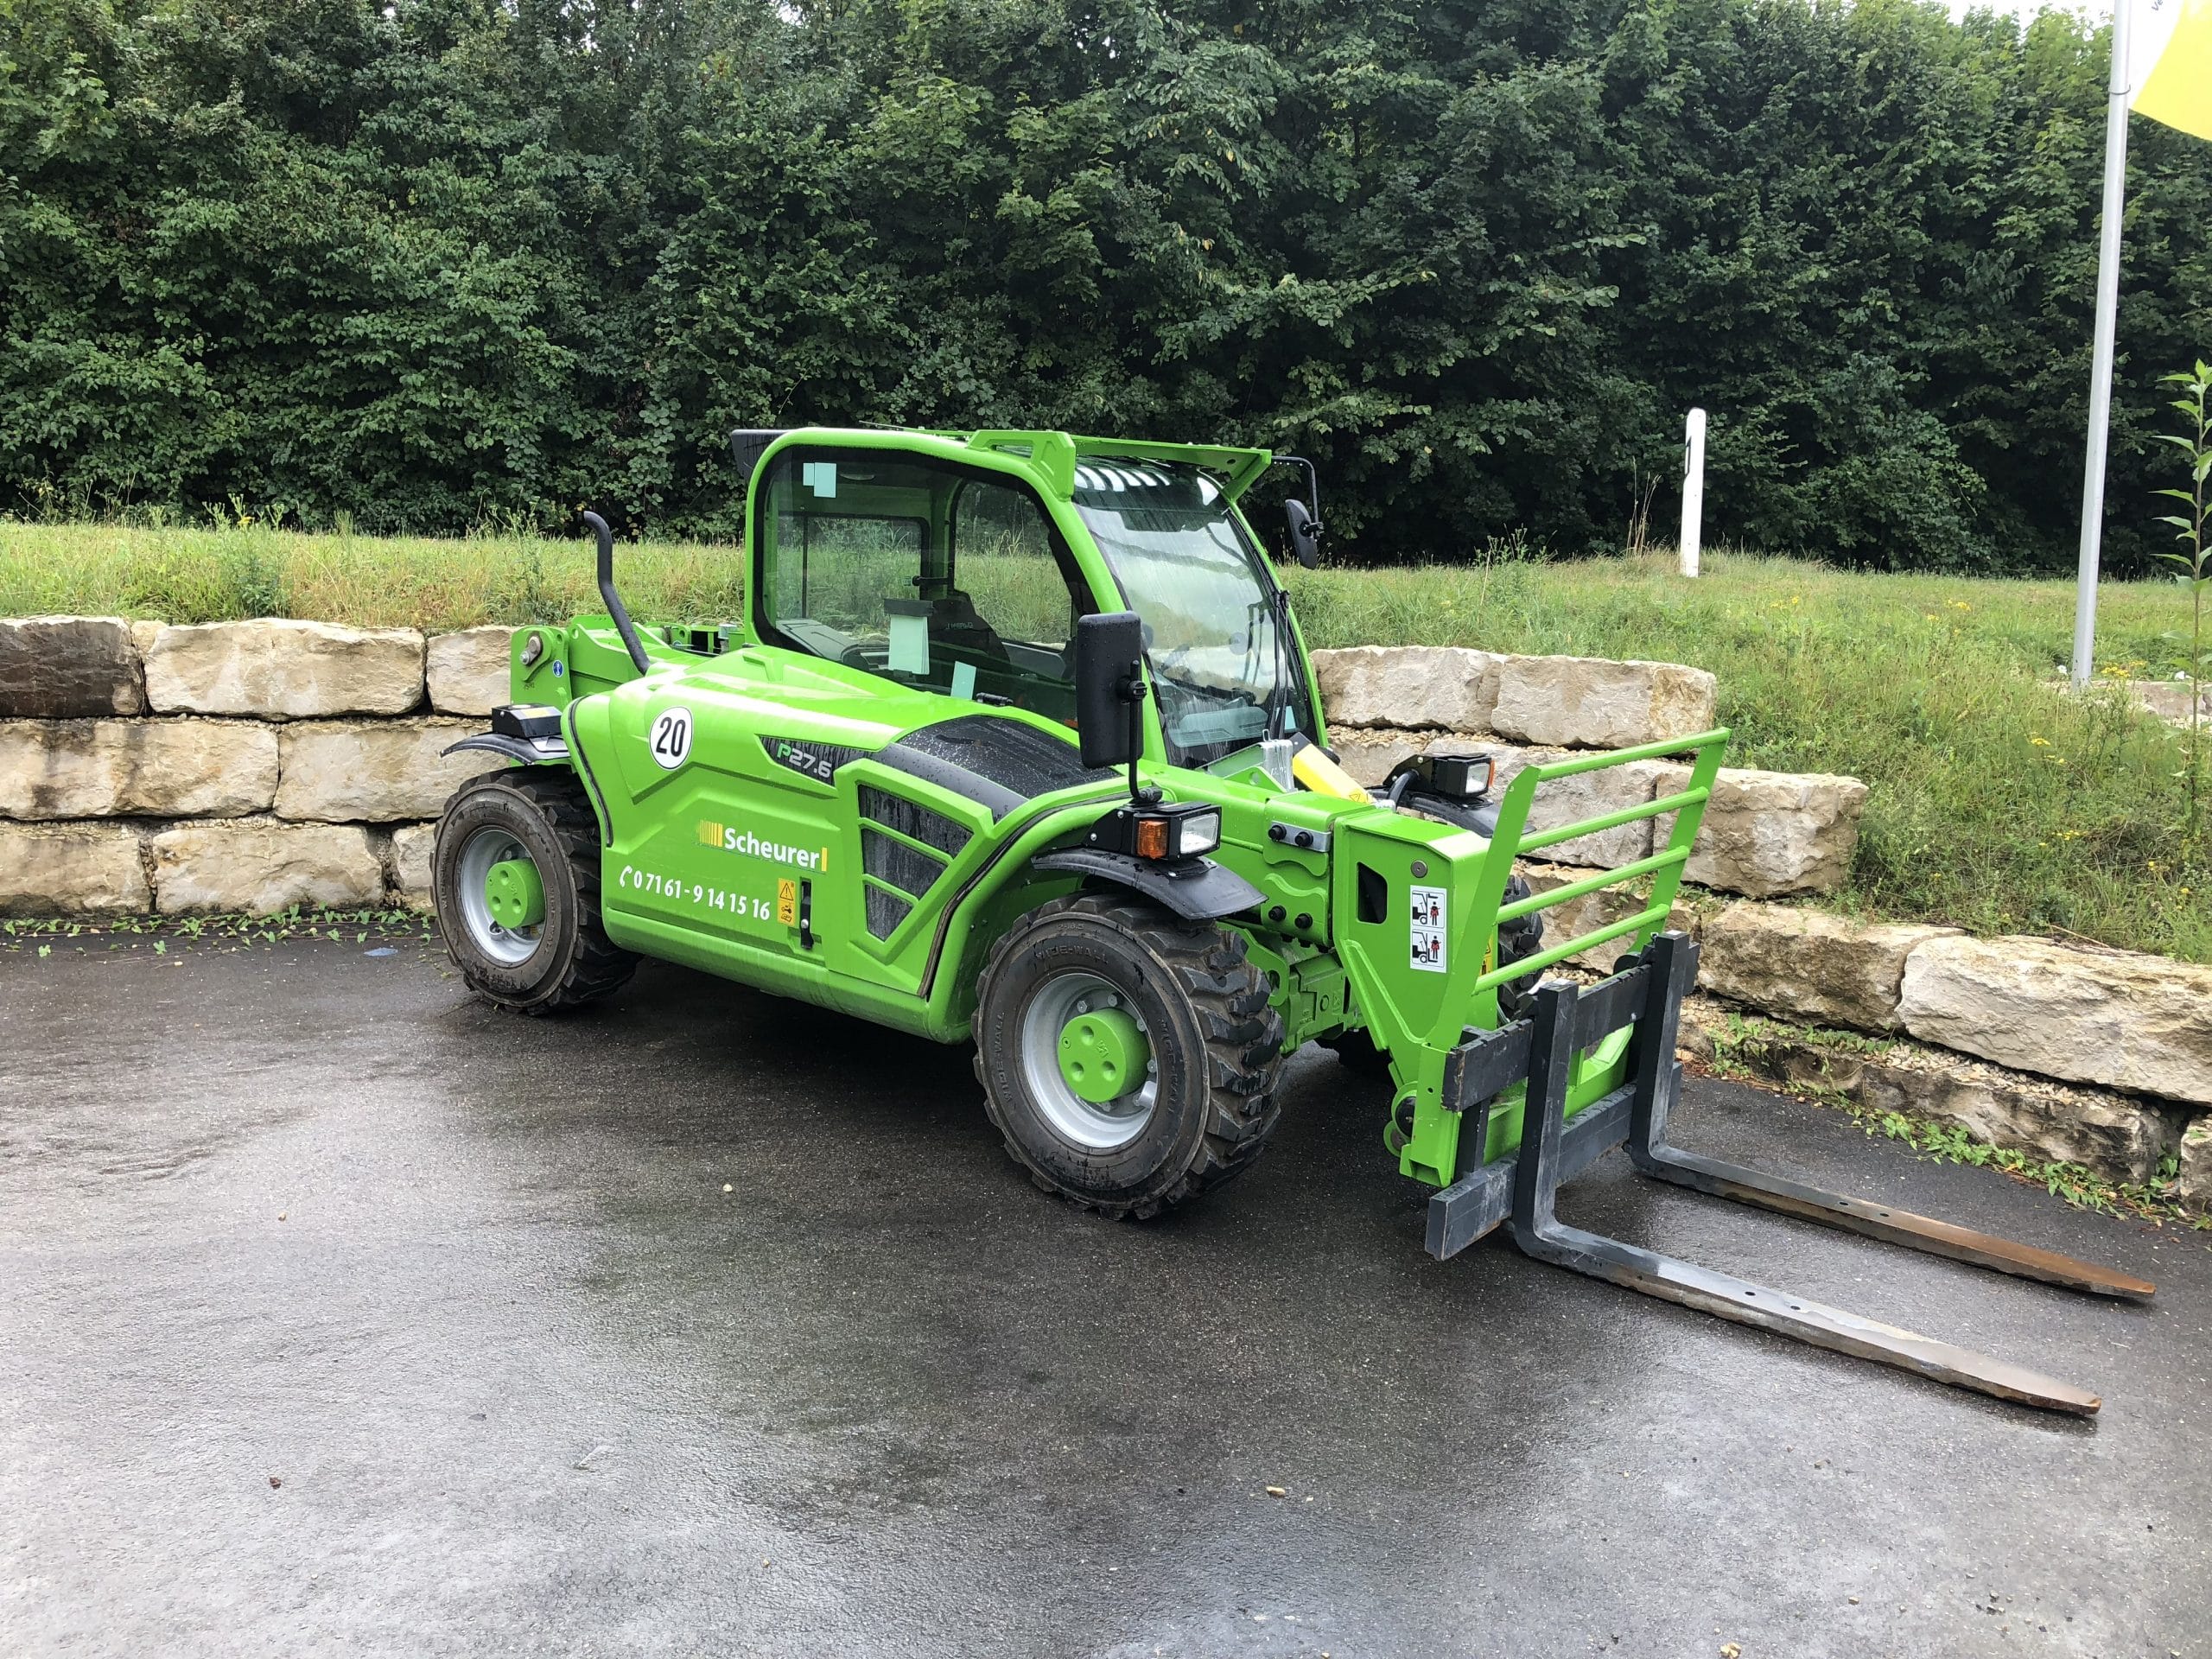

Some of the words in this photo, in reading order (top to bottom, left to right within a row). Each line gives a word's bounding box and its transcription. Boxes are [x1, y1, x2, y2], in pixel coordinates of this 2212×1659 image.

[656, 716, 686, 758] 20
[777, 742, 832, 779] P27.6
[724, 827, 820, 869] Scheurer
